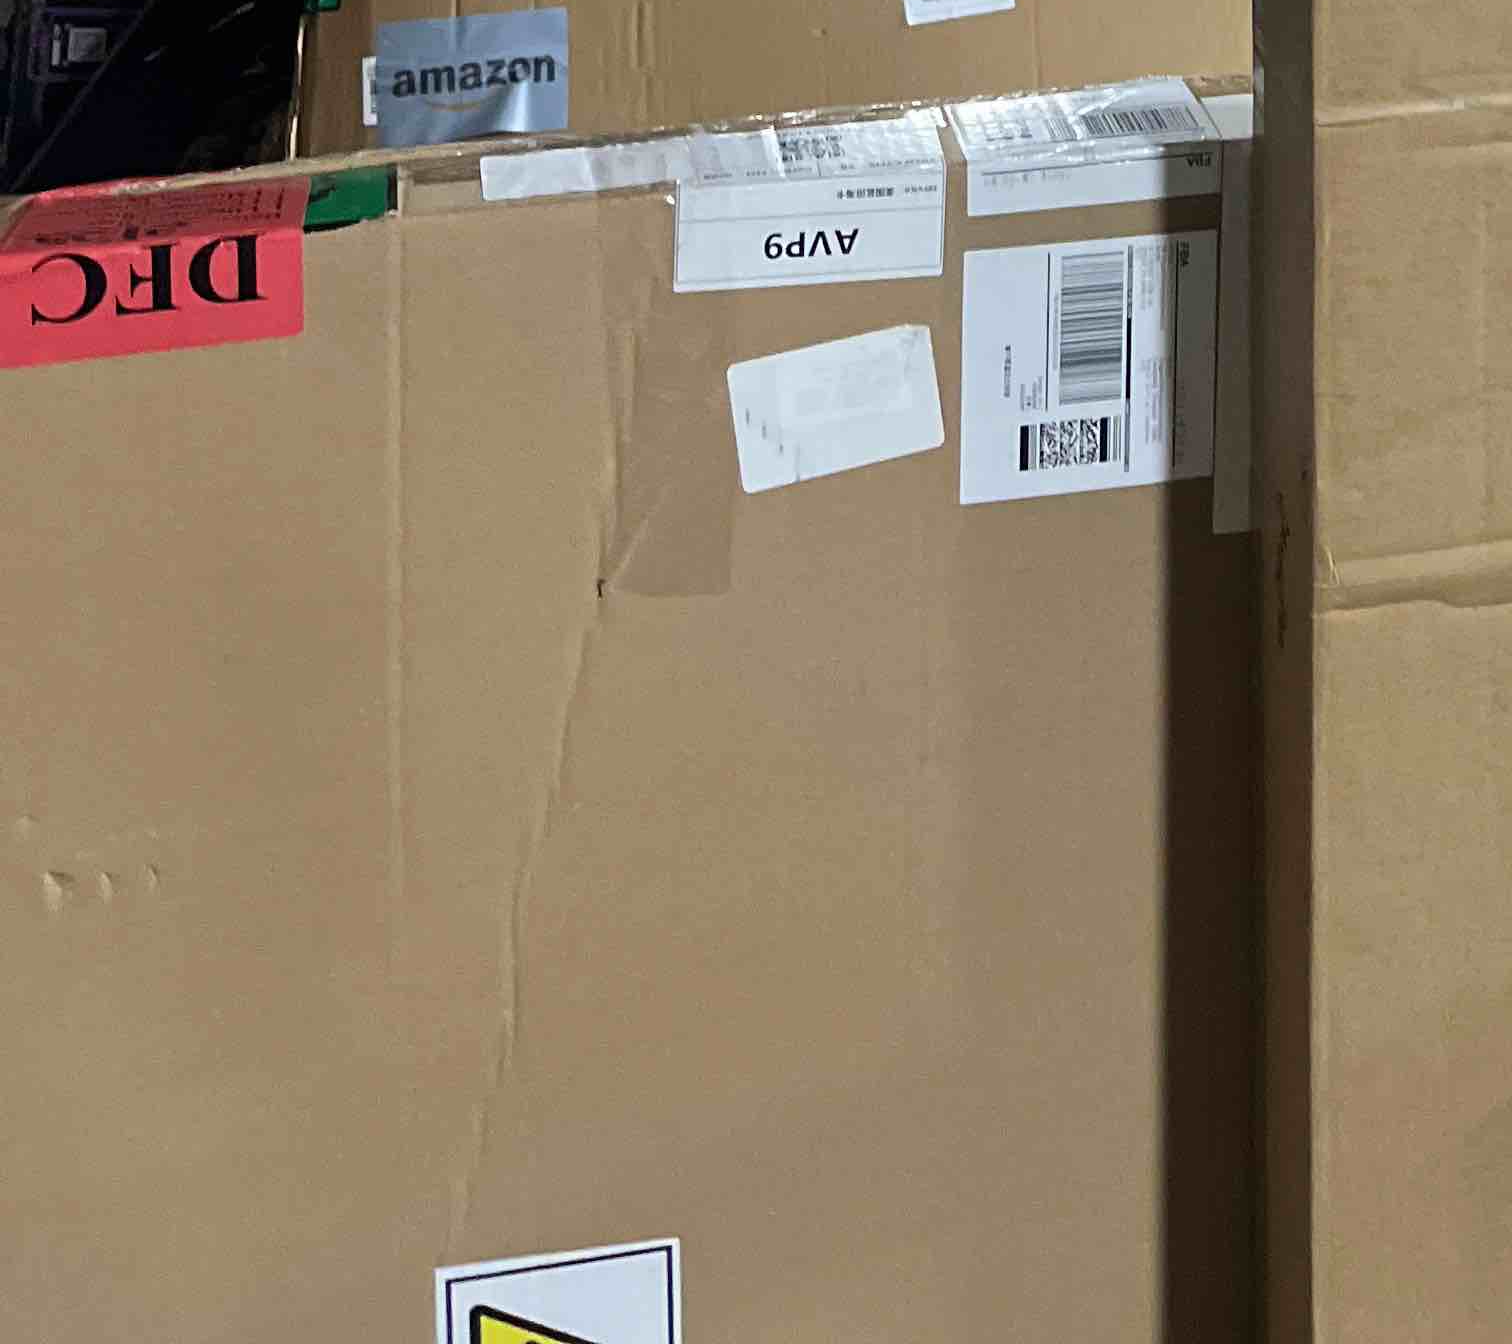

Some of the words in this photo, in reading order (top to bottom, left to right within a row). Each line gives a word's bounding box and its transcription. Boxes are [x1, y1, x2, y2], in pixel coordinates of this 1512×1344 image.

[391, 48, 556, 99] amazon
[763, 228, 860, 260] AVP9
[30, 231, 268, 326] DFC
